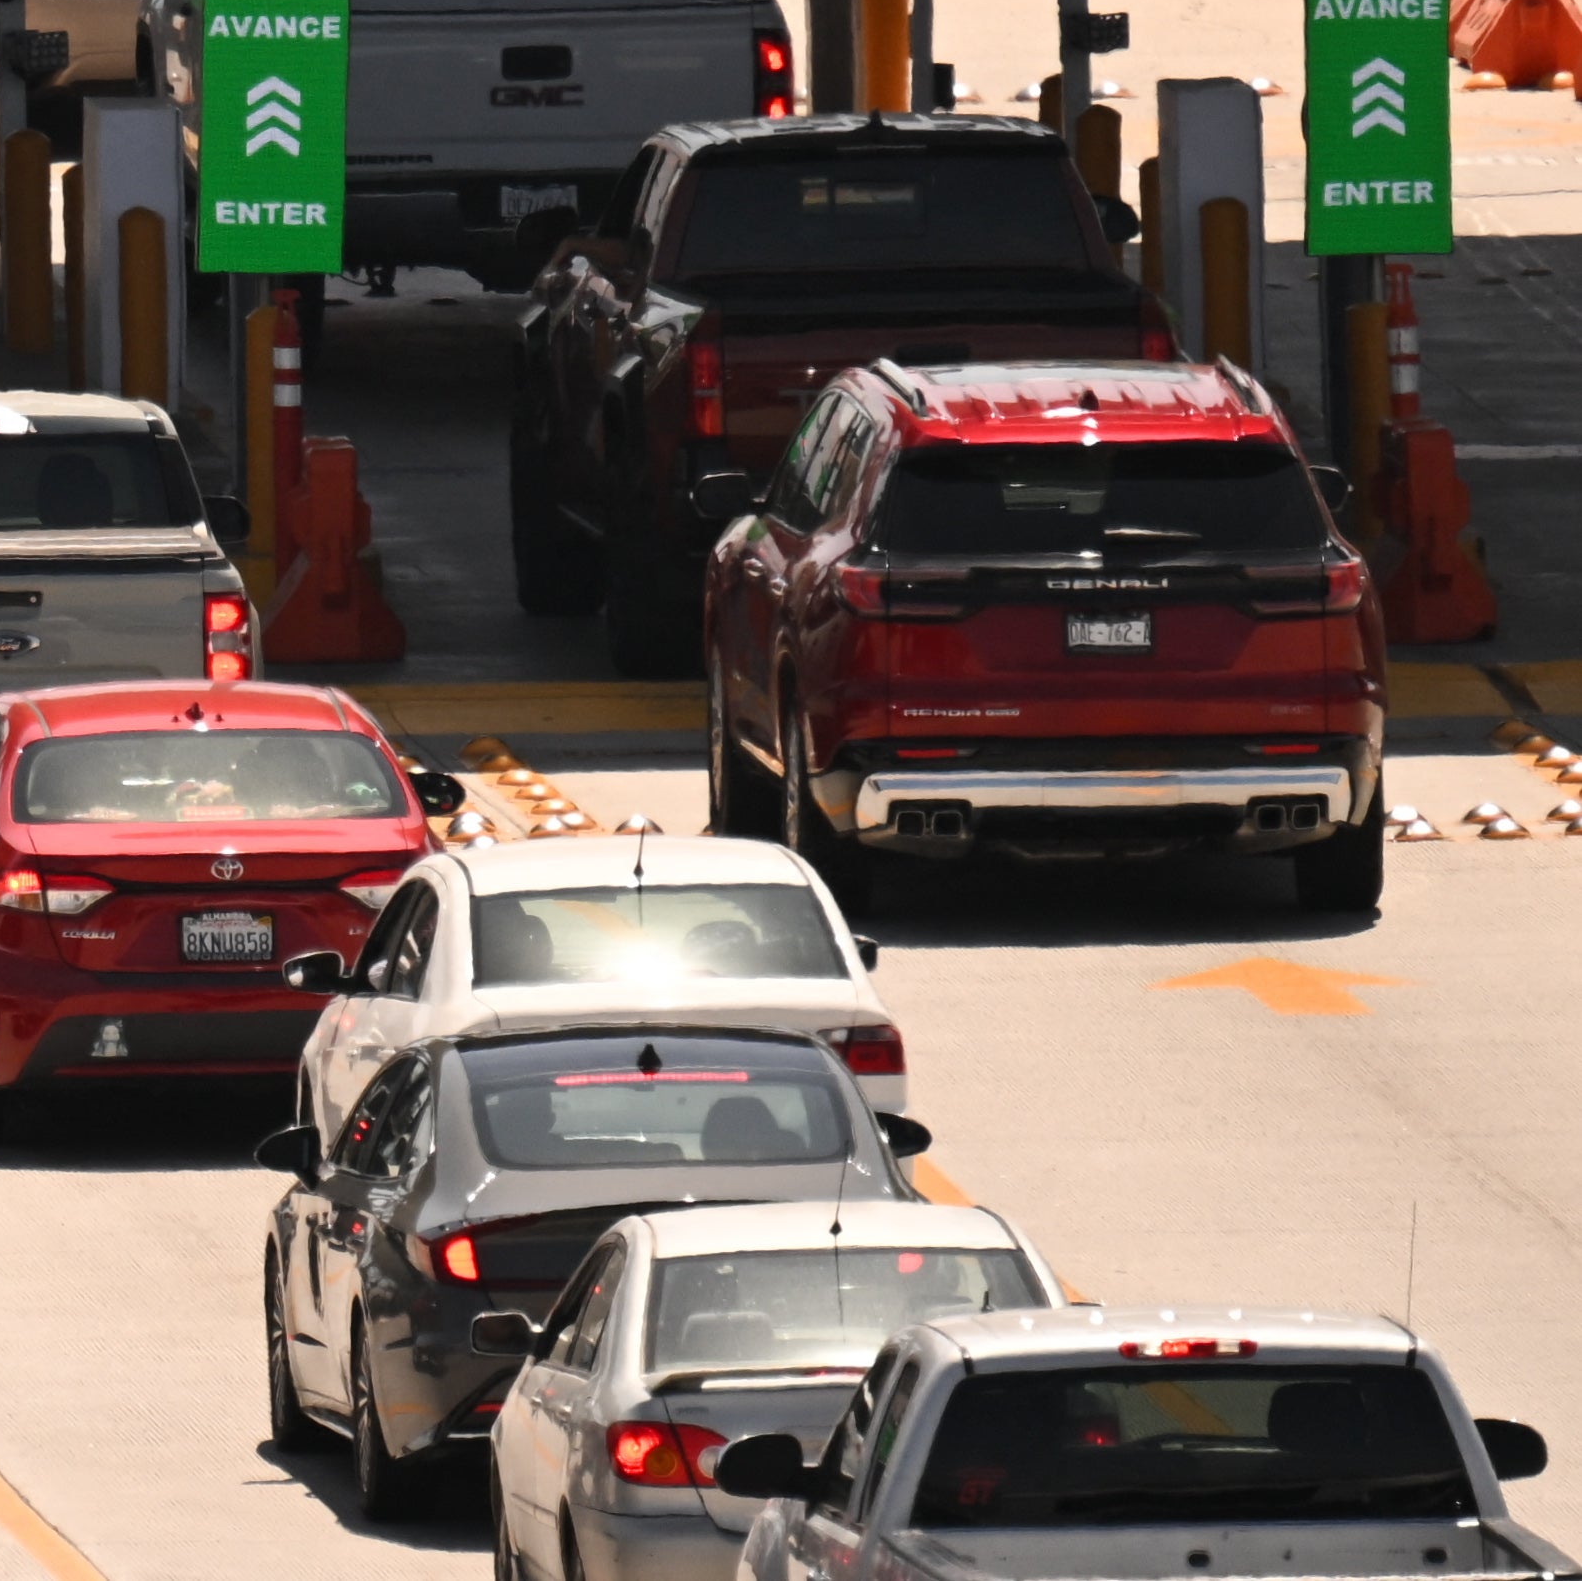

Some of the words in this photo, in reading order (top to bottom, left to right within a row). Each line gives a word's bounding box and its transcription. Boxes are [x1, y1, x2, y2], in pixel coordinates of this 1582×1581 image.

[209, 16, 342, 40] AVANCE
[490, 85, 585, 107] GMC
[1324, 181, 1435, 208] ENTER
[216, 202, 328, 228] ENTER
[1047, 578, 1169, 589] DENALI
[186, 931, 272, 954] 8KNU858
